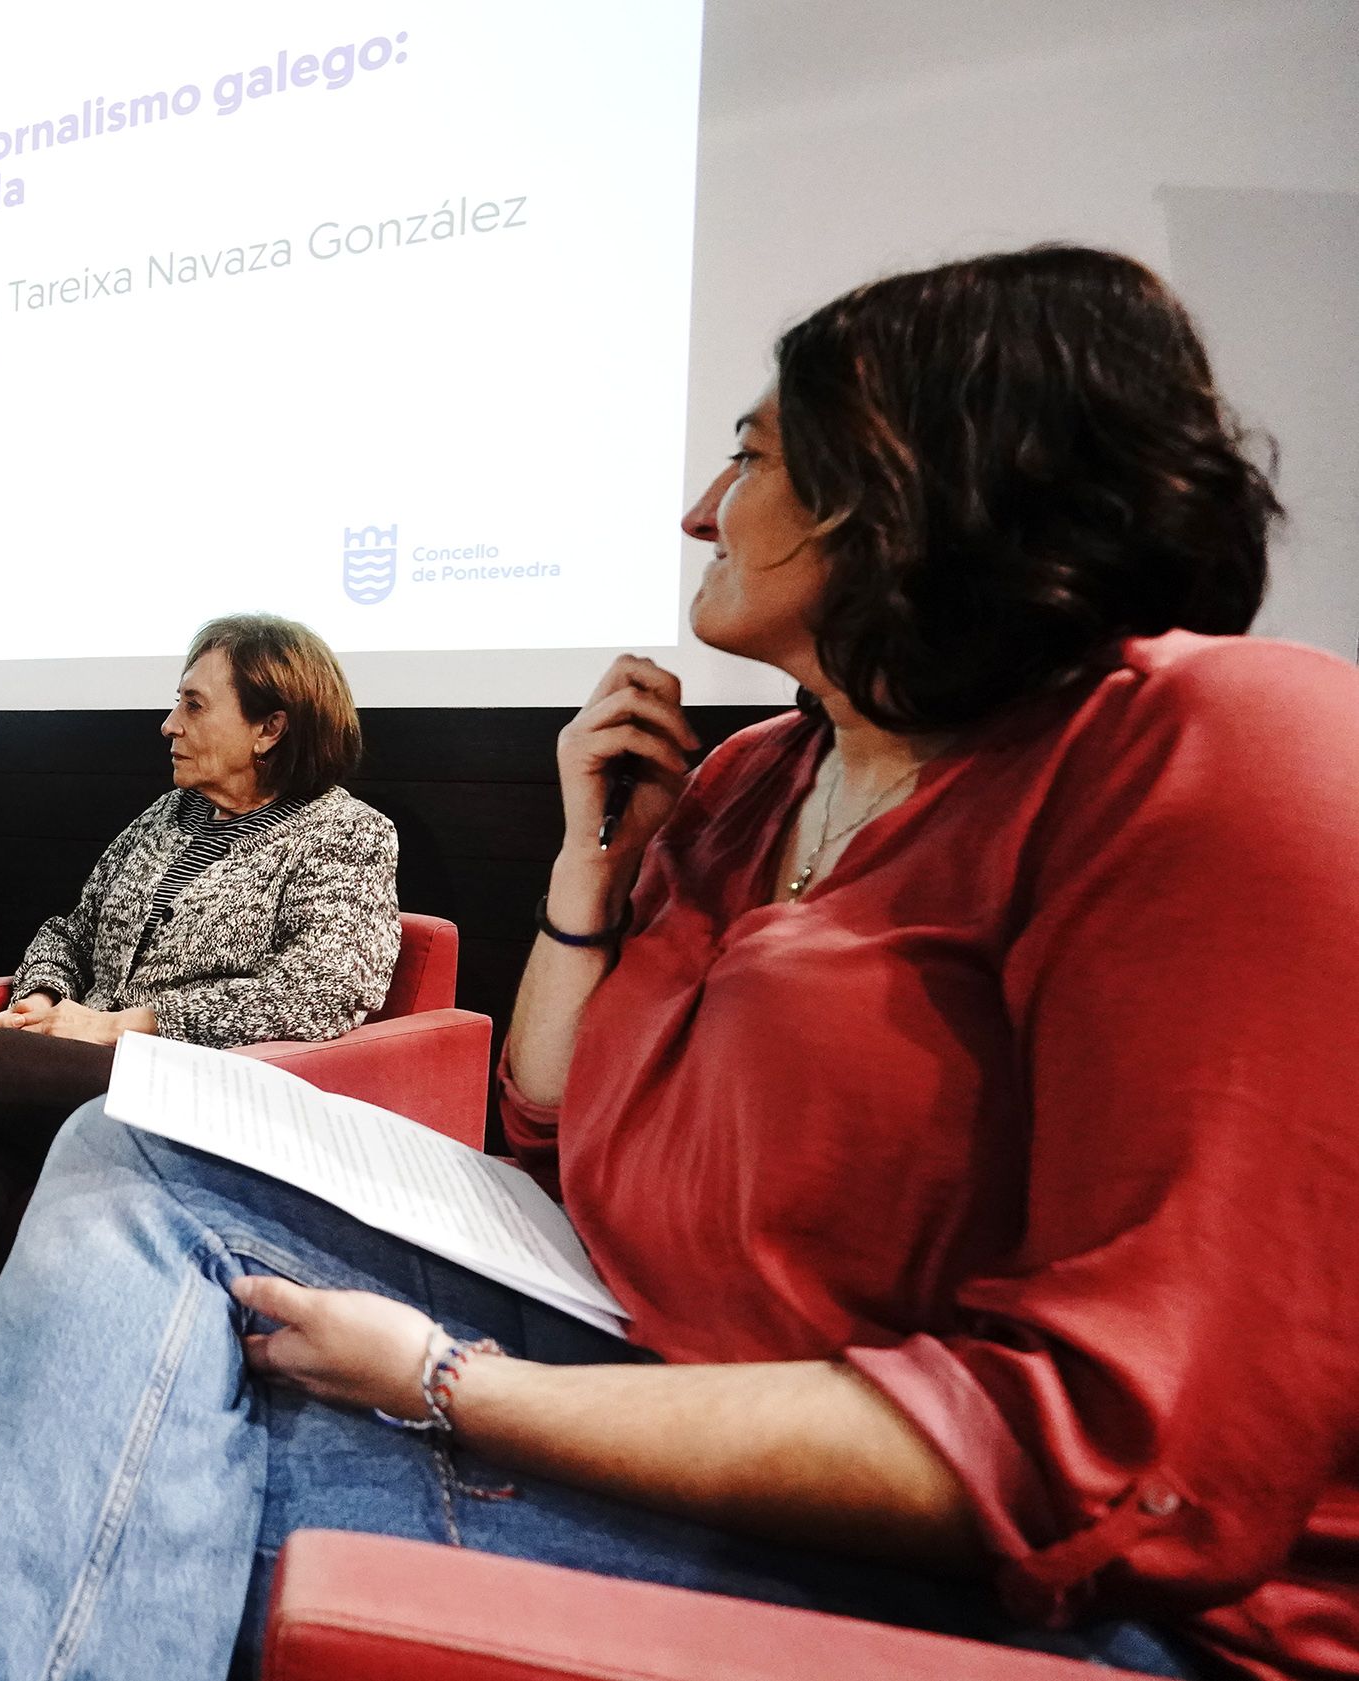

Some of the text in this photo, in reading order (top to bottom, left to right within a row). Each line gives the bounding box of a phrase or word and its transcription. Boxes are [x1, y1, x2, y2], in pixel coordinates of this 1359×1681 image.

[213, 31, 408, 116] galego:
[9, 267, 132, 311] Tareixa
[148, 238, 292, 289] Navaza
[309, 195, 527, 260] González
[412, 543, 499, 563] Concello
[412, 561, 561, 582] de Pontevedra
